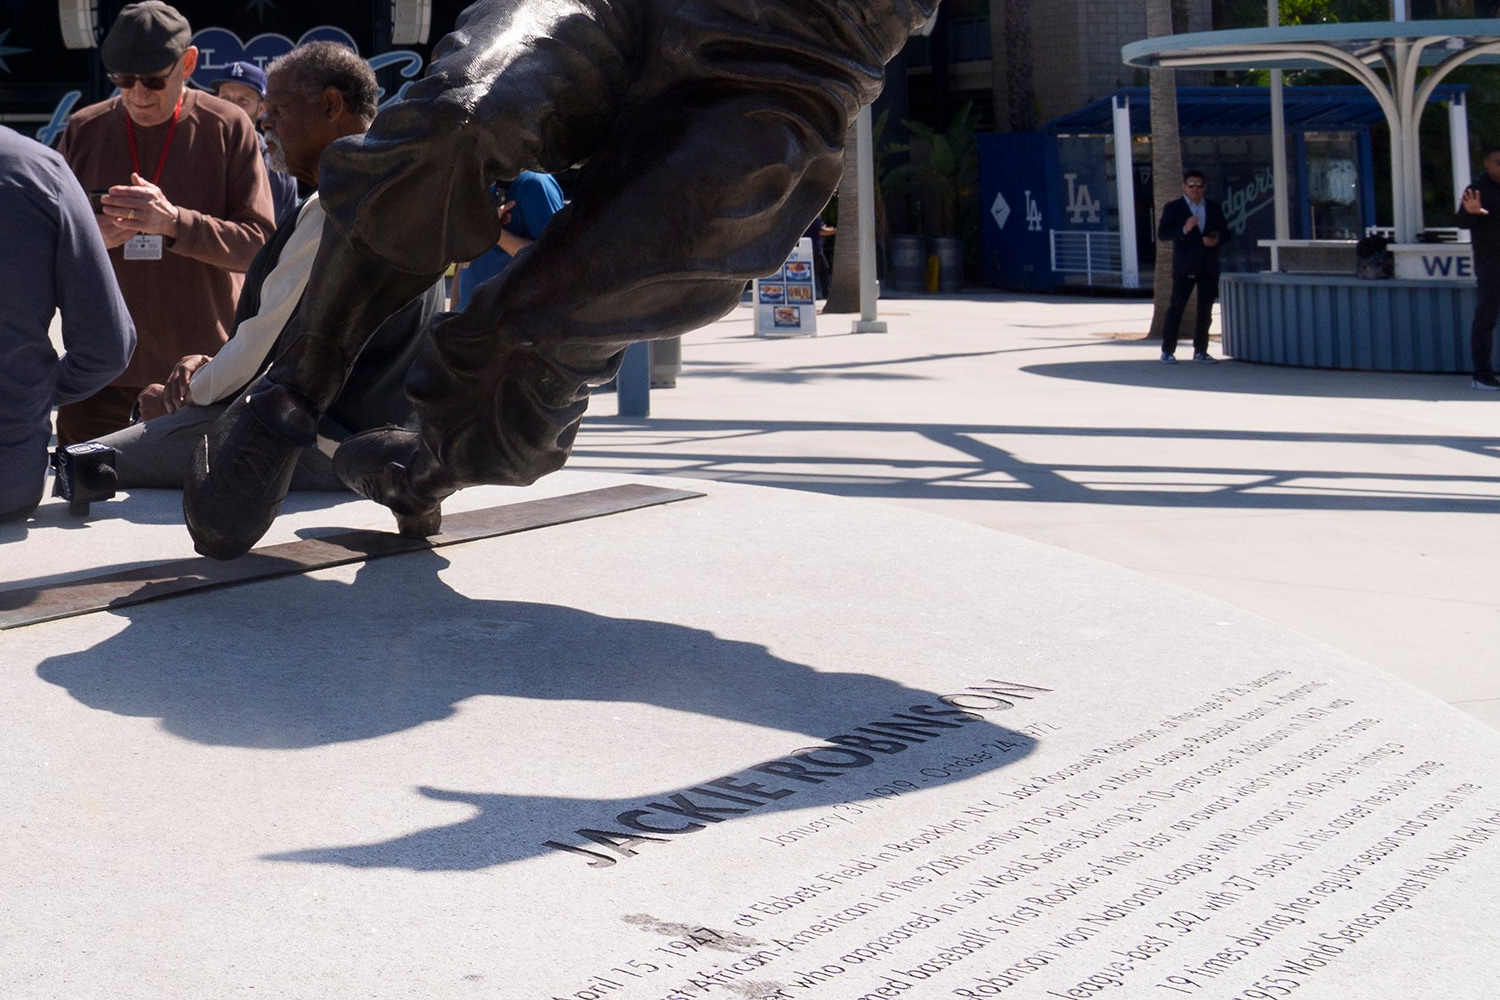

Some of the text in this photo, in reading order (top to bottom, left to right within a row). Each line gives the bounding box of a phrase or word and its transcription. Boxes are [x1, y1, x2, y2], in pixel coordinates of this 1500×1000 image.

[1063, 173, 1100, 223] LA
[1024, 190, 1043, 231] LA
[1139, 744, 1200, 766] League
[541, 679, 1054, 868] JACKIE ROBINSON
[1103, 765, 1153, 784] Major
[1261, 761, 1308, 777] today
[1321, 767, 1362, 783] after
[1065, 790, 1103, 800] for
[1228, 777, 1272, 796] which
[1287, 782, 1335, 798] 1949
[1378, 779, 1417, 796] stole
[757, 813, 856, 847] January
[864, 780, 922, 800] 1919
[918, 750, 995, 778] October
[1189, 796, 1240, 819] award
[1272, 801, 1308, 809] in
[1359, 796, 1391, 806] he
[1041, 801, 1090, 819] play
[1327, 805, 1373, 828] career
[1020, 817, 1052, 825] to
[1169, 820, 1200, 831] an
[1235, 809, 1295, 835] honors
[966, 826, 1040, 855] century
[1201, 834, 1242, 852] MVP
[1300, 829, 1340, 841] his
[1283, 841, 1320, 851] In
[915, 855, 975, 876] 20th
[1086, 863, 1118, 875] of
[1101, 851, 1144, 866] the
[550, 976, 625, 1000] pril
[732, 914, 763, 926] at
[748, 884, 832, 915] Ebbets
[814, 859, 879, 884] Field
[861, 852, 900, 862] in
[1003, 783, 1043, 800] Jack
[1030, 754, 1105, 784] Roosevelt
[1146, 854, 1221, 885] League
[788, 964, 846, 989] who
[838, 912, 941, 964] appeared
[922, 904, 963, 915] in
[953, 890, 990, 904] six
[975, 861, 1040, 889] World
[1020, 839, 1087, 864] Series
[1069, 814, 1143, 838] during
[1116, 802, 1157, 814] his
[1138, 776, 1203, 800] 10-year
[887, 875, 933, 892] the
[1023, 876, 1100, 907] Rookie
[1220, 875, 1260, 891] 37
[860, 892, 901, 903] in
[1079, 884, 1164, 926] National
[1155, 975, 1203, 994] 19
[1183, 948, 1249, 978] times
[1225, 914, 1305, 947] during
[1275, 897, 1321, 914] the
[1307, 864, 1365, 896] regular
[1352, 837, 1402, 865] season
[1393, 820, 1429, 836] and
[1416, 803, 1455, 820] once
[1438, 795, 1464, 804] in
[1202, 890, 1242, 912] with
[987, 906, 1042, 926] first
[1154, 910, 1211, 934] .342
[1233, 826, 1496, 1000] 955 World Series against the New York
[684, 902, 879, 992] African-American
[1053, 927, 1099, 948] won
[891, 927, 1009, 979] baseball's
[951, 950, 1056, 1000] Robinson
[1046, 935, 1173, 1000] league-best
